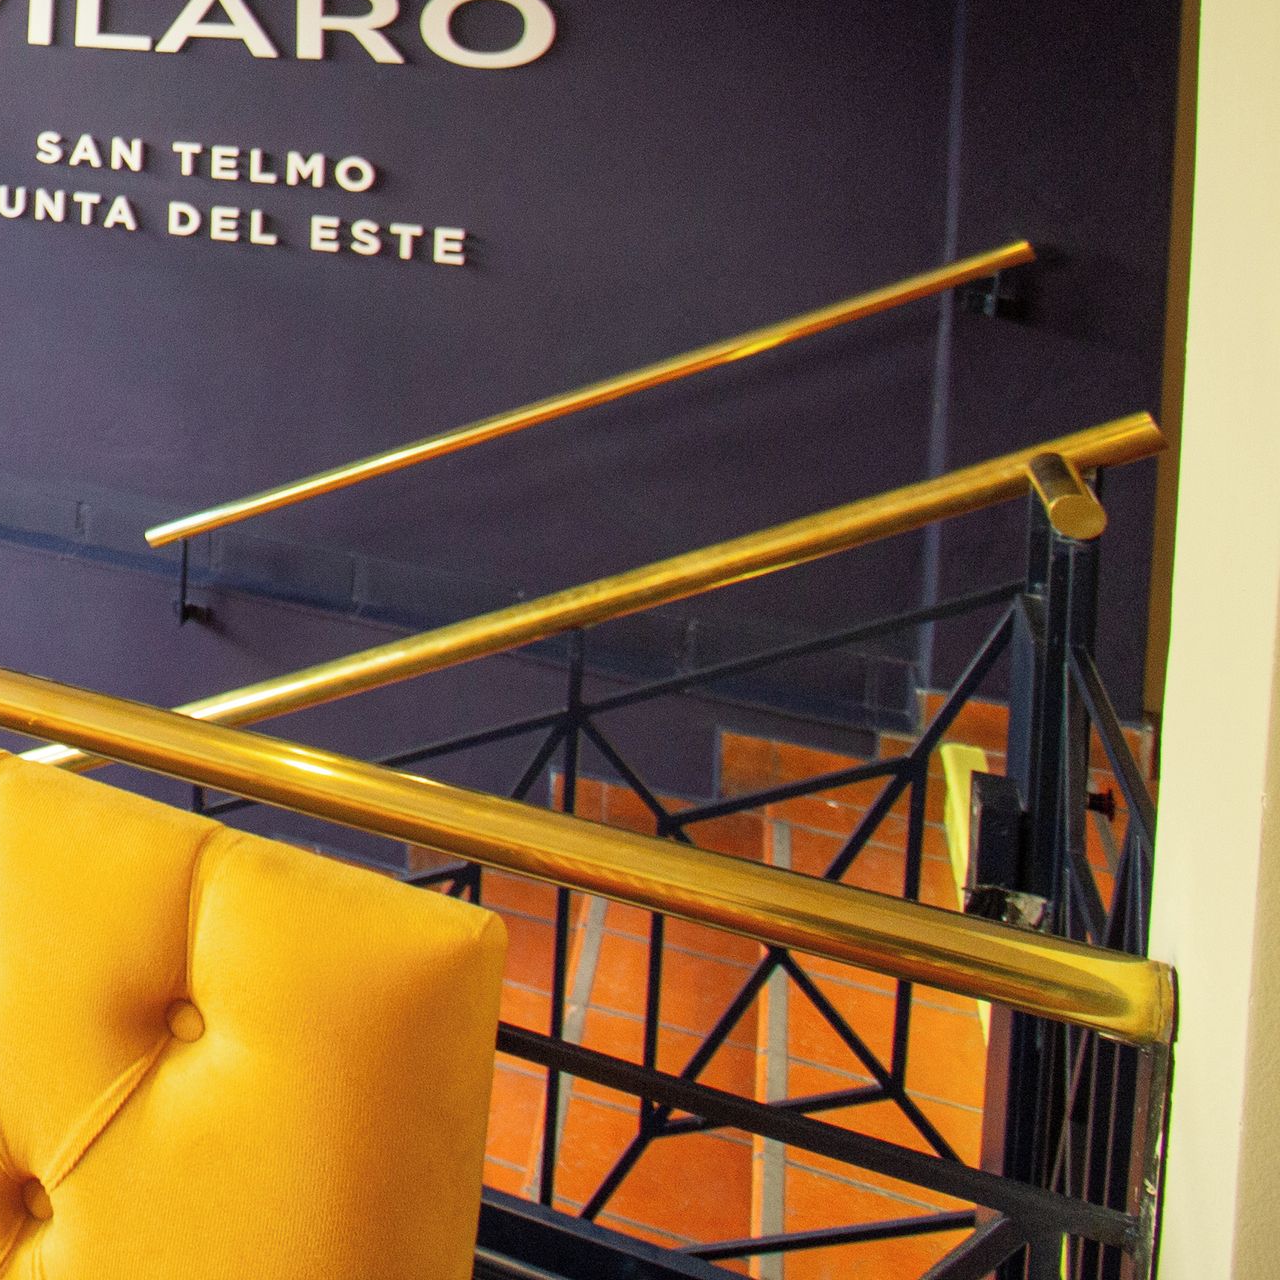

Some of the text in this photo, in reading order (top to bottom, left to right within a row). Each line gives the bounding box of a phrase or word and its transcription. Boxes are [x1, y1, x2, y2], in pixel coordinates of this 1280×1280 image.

[35, 130, 375, 192] SAN TELMO
[168, 200, 278, 245] DEL
[310, 214, 466, 265] ESTE
